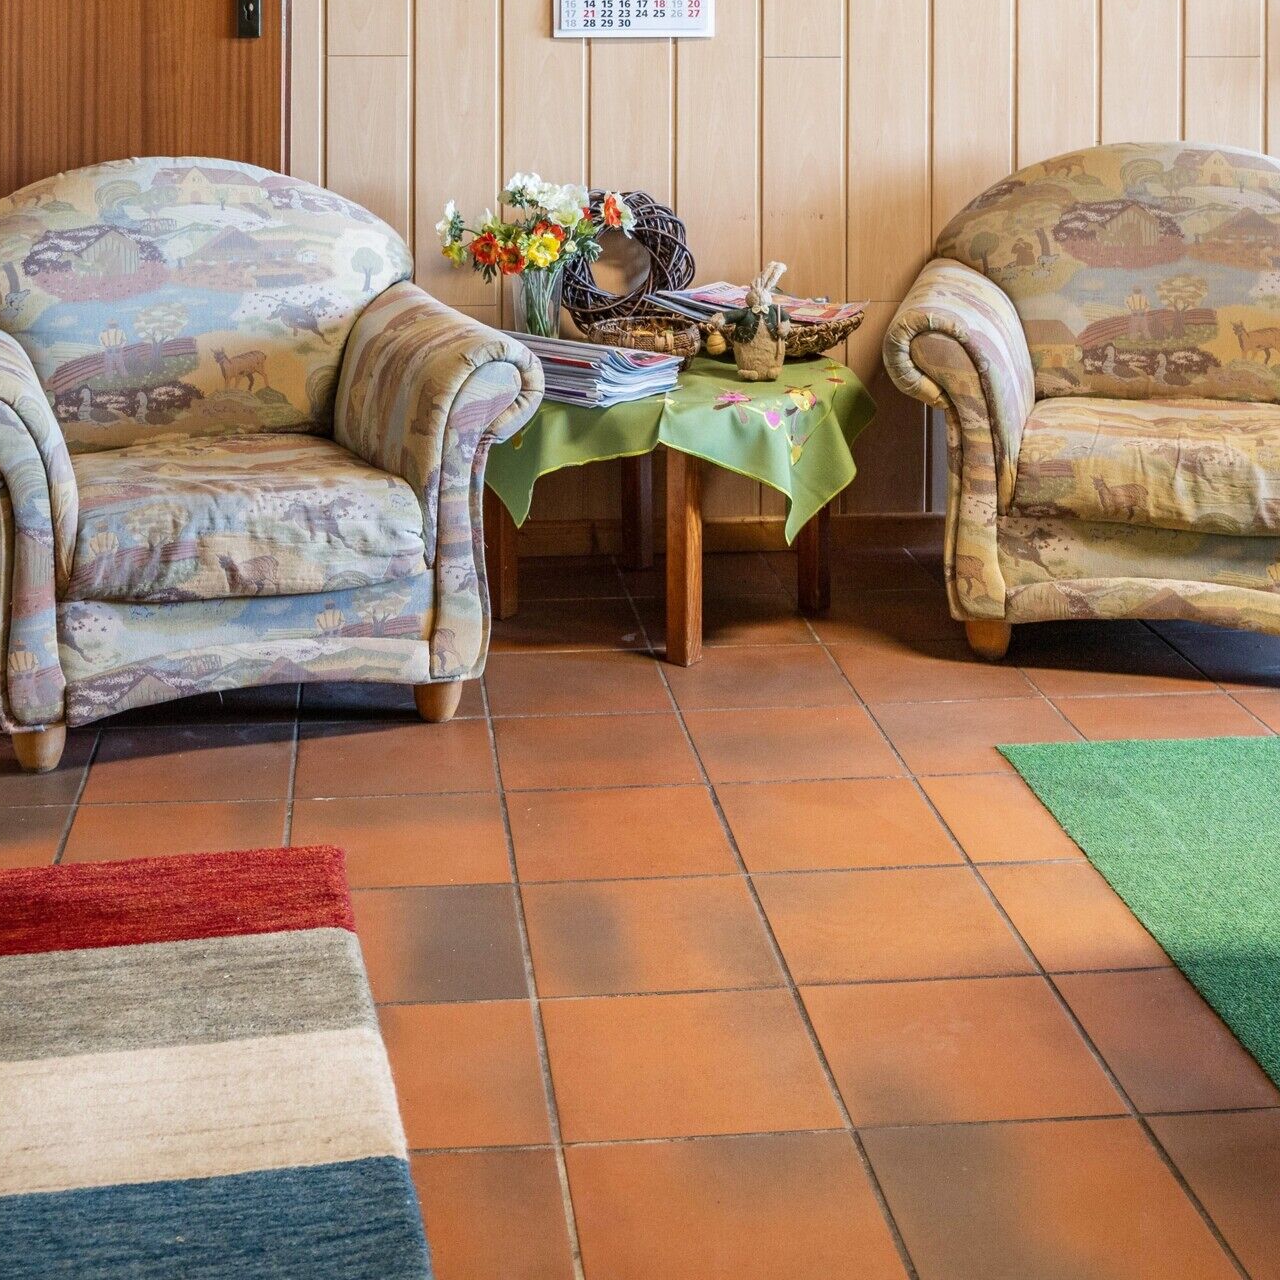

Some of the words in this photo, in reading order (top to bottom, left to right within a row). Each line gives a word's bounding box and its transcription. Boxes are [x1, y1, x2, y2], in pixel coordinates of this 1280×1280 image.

[584, 0, 596, 8] 14
[602, 0, 613, 8] 15
[619, 0, 631, 8] 16
[637, 0, 648, 8] 17
[654, 0, 665, 8] 18
[688, 0, 700, 8] 20
[584, 10, 595, 18] 21
[601, 9, 613, 18] 22
[618, 9, 630, 18] 23
[636, 9, 648, 17] 24
[653, 9, 665, 17] 25
[688, 9, 700, 17] 27
[583, 19, 596, 27] 28
[601, 19, 613, 27] 29
[618, 19, 631, 27] 30
